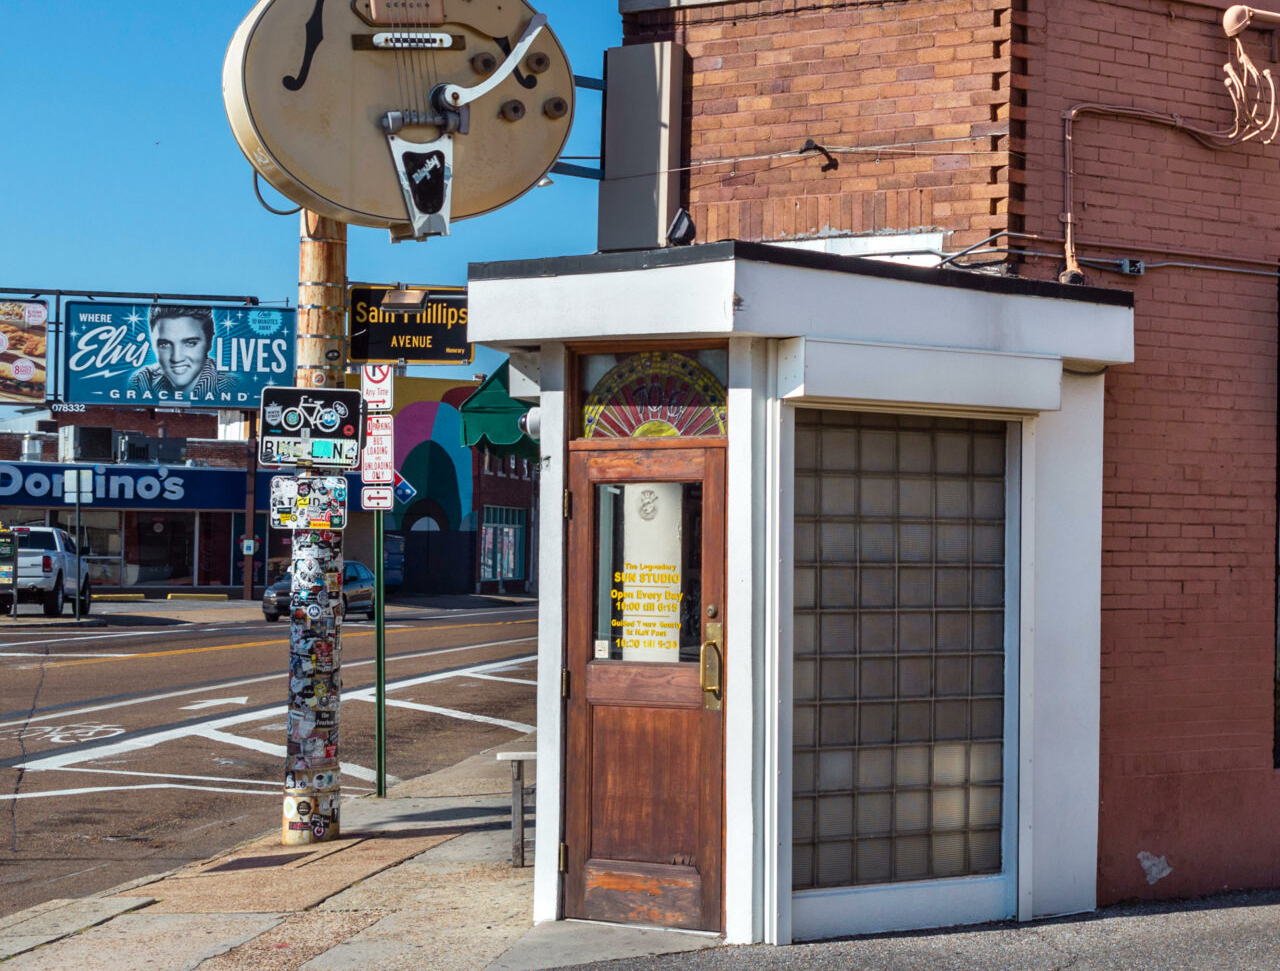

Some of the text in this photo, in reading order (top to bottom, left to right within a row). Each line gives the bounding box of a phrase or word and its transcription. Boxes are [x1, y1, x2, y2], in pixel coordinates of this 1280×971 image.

[79, 312, 112, 324] WHERE
[355, 301, 395, 324] Sam
[390, 335, 432, 348] AVENUE
[69, 326, 287, 374] Elvis LIVES
[109, 388, 249, 403] GRACELAND
[366, 388, 389, 397] Any Time
[51, 403, 86, 413] 078332
[372, 422, 391, 431] PARKING
[373, 437, 383, 446] BUS
[366, 447, 388, 456] LOADING
[364, 462, 392, 471] UNLOADING
[372, 471, 384, 480] ONLY
[625, 562, 676, 573] The Legendary
[614, 572, 680, 584] SUN STUDIO
[611, 589, 683, 602] Open Every Day
[616, 601, 640, 611] 10:00
[643, 601, 655, 612] till
[611, 619, 682, 631] Guided Tours Hourly
[635, 629, 649, 637] Half
[643, 639, 655, 649] till
